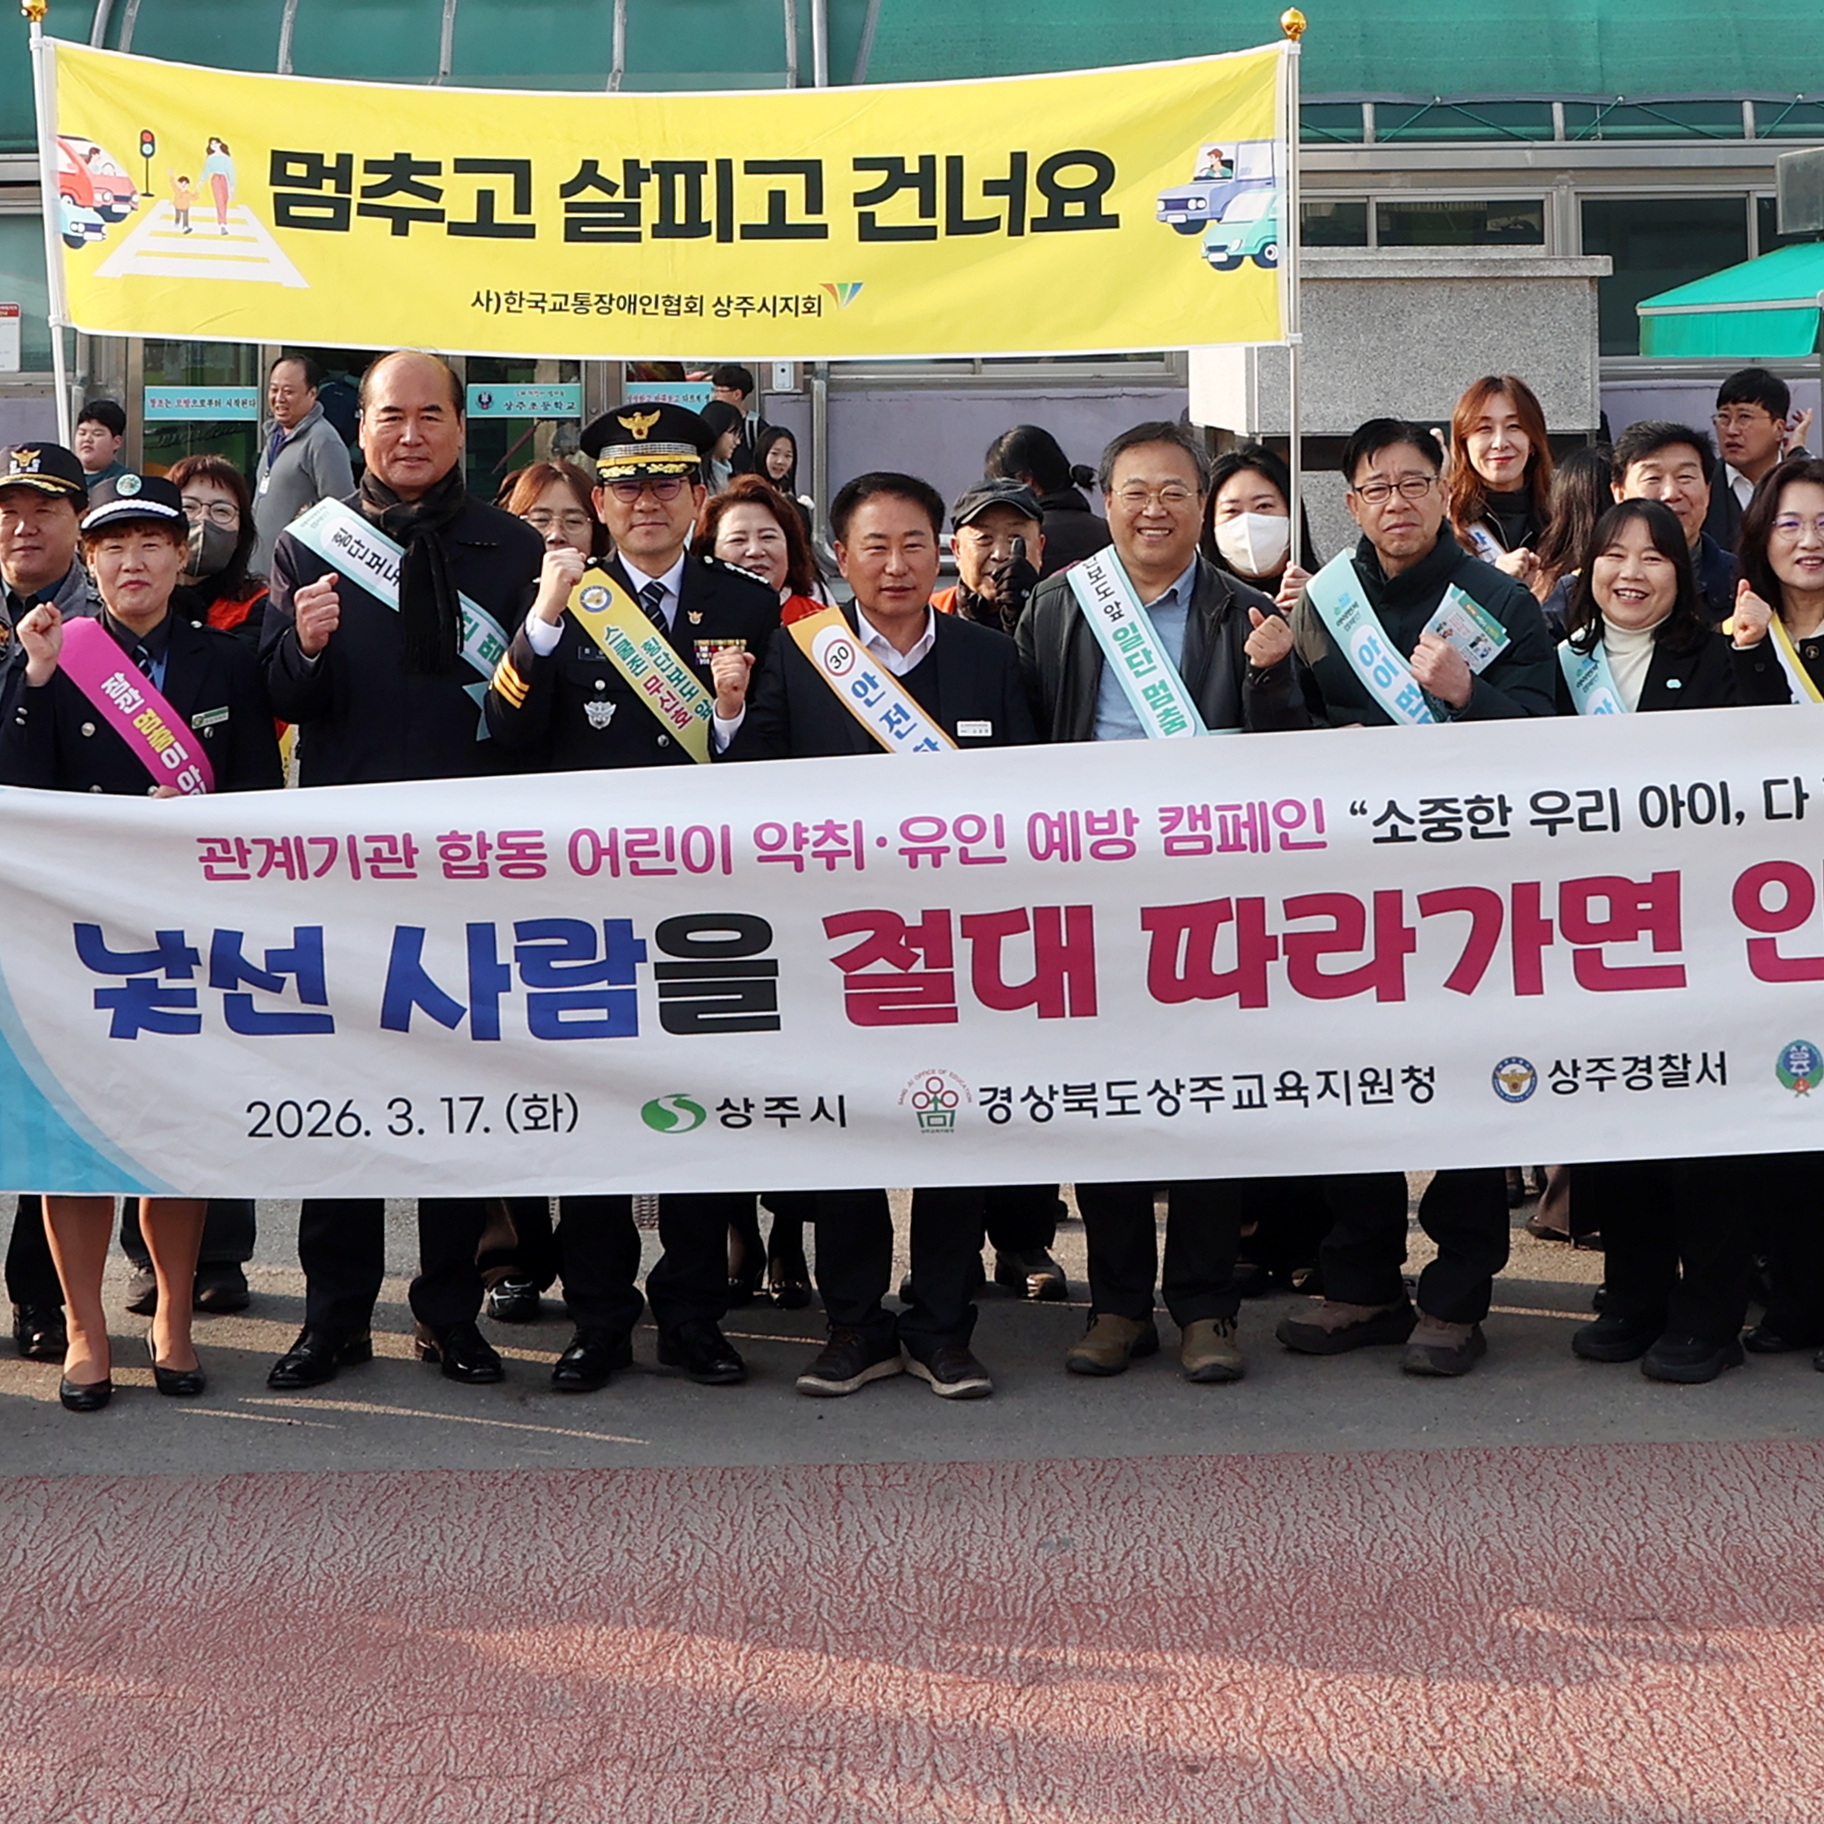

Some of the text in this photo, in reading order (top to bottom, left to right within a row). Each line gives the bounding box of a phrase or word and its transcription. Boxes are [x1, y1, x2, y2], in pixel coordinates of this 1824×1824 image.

[269, 147, 1119, 244] 멈추고 살피고 건너요
[471, 288, 824, 322] 사)한국교통장애인협회 상주시지회
[504, 401, 576, 412] 상주초등학교
[332, 527, 403, 587] 횡단보도
[1103, 600, 1125, 623] 앞
[604, 625, 694, 730] 스쿨존 무신호
[640, 637, 713, 721] 횡단보도 앞
[829, 645, 850, 670] 30
[1112, 621, 1158, 679] 일단
[1358, 635, 1400, 690] 아이
[101, 672, 145, 715] 잠깐
[132, 707, 190, 770] 멈춤이
[1141, 678, 1188, 737] 멈춤
[196, 831, 419, 884] 관계기관
[436, 826, 548, 883] 합동
[567, 822, 734, 881] 어린이
[754, 810, 1007, 873] 약취·유인
[1025, 803, 1140, 865] 예방
[1157, 796, 1329, 857] 캠페인
[1348, 794, 1512, 847] “소중한
[1528, 786, 1623, 840] 우리
[1636, 779, 1746, 832] 아이,
[1761, 776, 1810, 824] 다
[73, 920, 336, 1043] 낯선
[379, 911, 782, 1044] 사람을
[822, 902, 1100, 1029] 절대
[1139, 870, 1689, 1011] 따라가면
[978, 1061, 1437, 1126] 경상북도상주교육지원청
[1547, 1049, 1729, 1096] 상주경찰서
[246, 1096, 373, 1142] 2026.
[388, 1097, 430, 1139] 3.
[503, 1090, 582, 1138] (화)
[715, 1092, 849, 1134] 상주시
